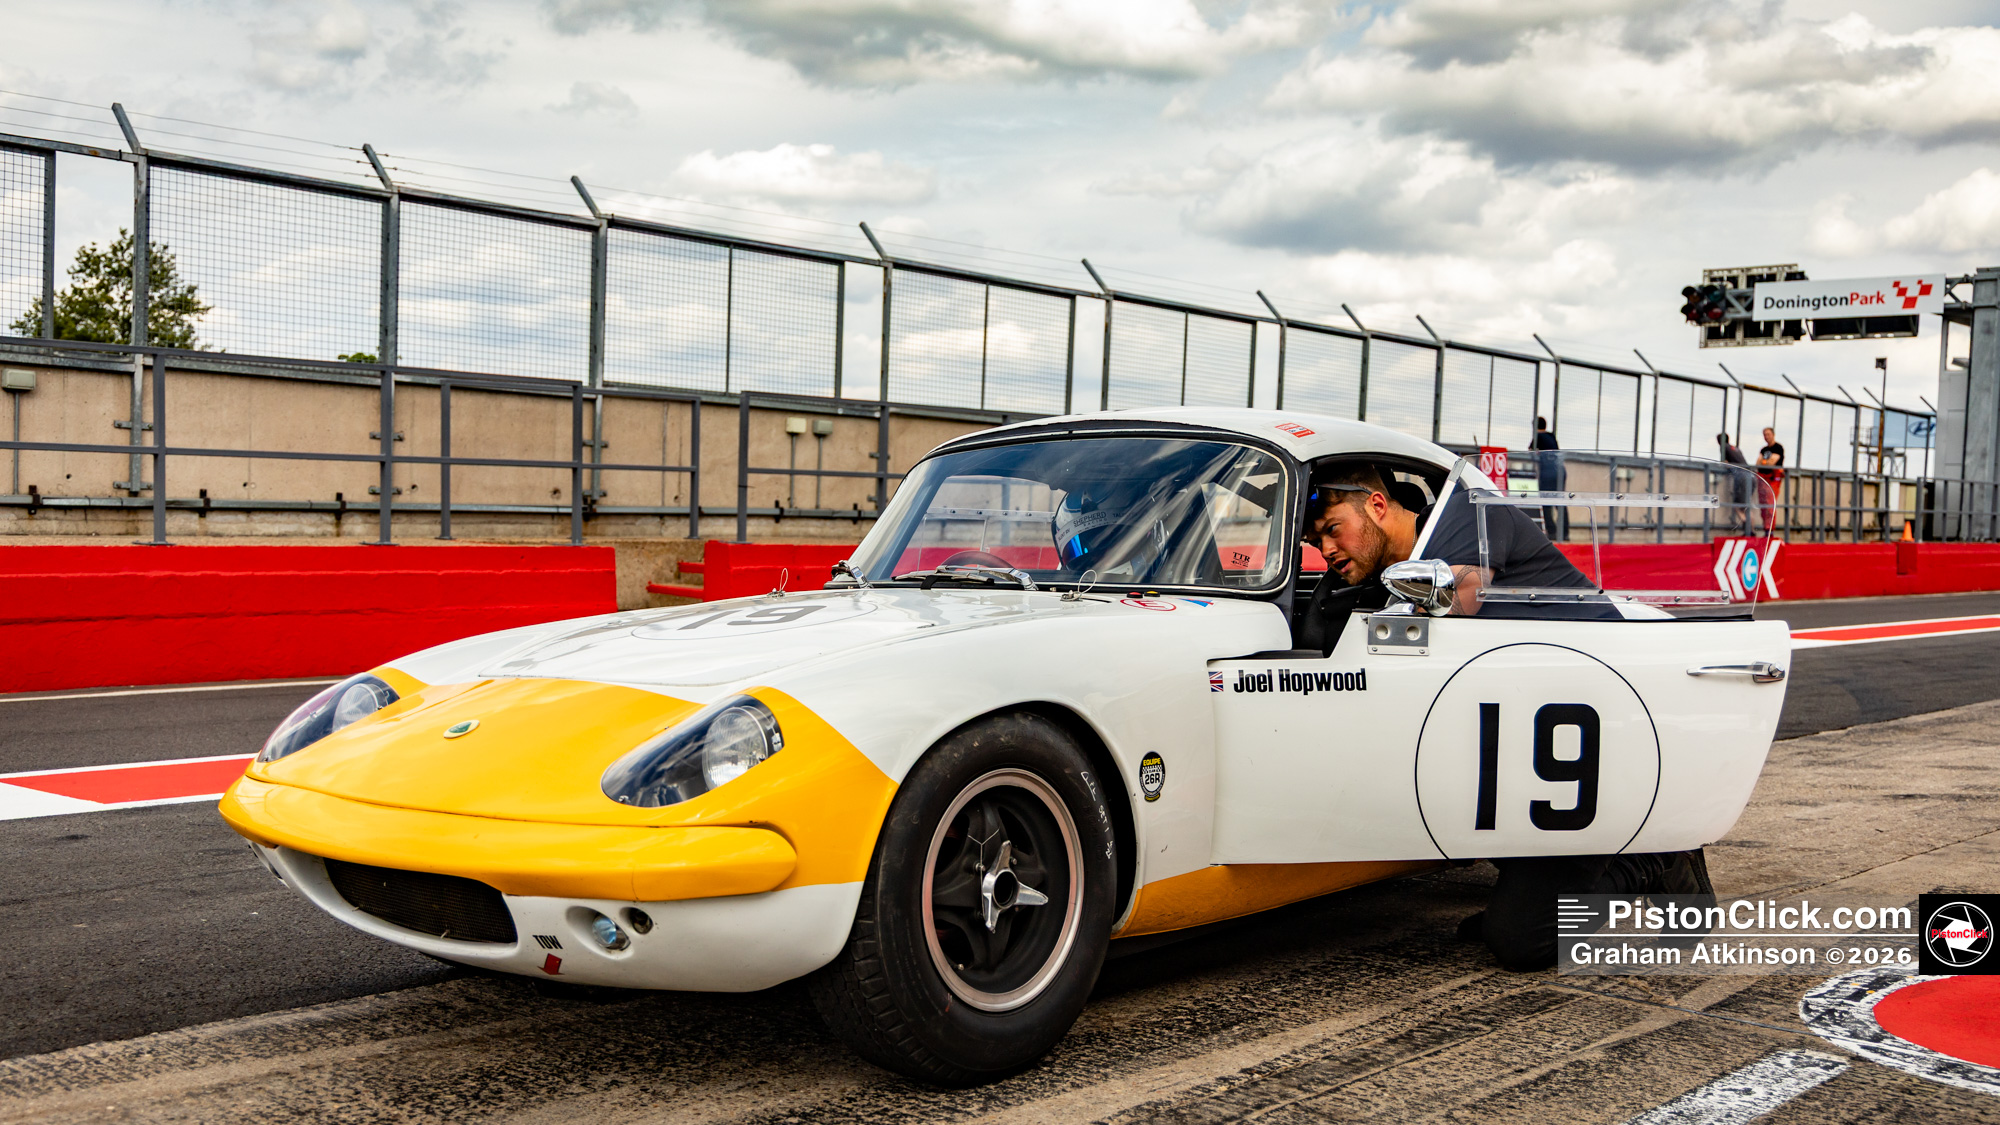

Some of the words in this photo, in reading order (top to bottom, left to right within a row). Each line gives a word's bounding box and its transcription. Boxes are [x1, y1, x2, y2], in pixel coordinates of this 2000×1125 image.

[1073, 511, 1107, 528] SHEPHERD
[1233, 551, 1250, 563] TTR
[677, 605, 827, 631] 19
[1233, 669, 1274, 693] Joel
[1278, 668, 1367, 696] Hopwood
[1475, 703, 1600, 831] 19
[1145, 773, 1160, 785] 26R
[532, 935, 563, 949] TOW
